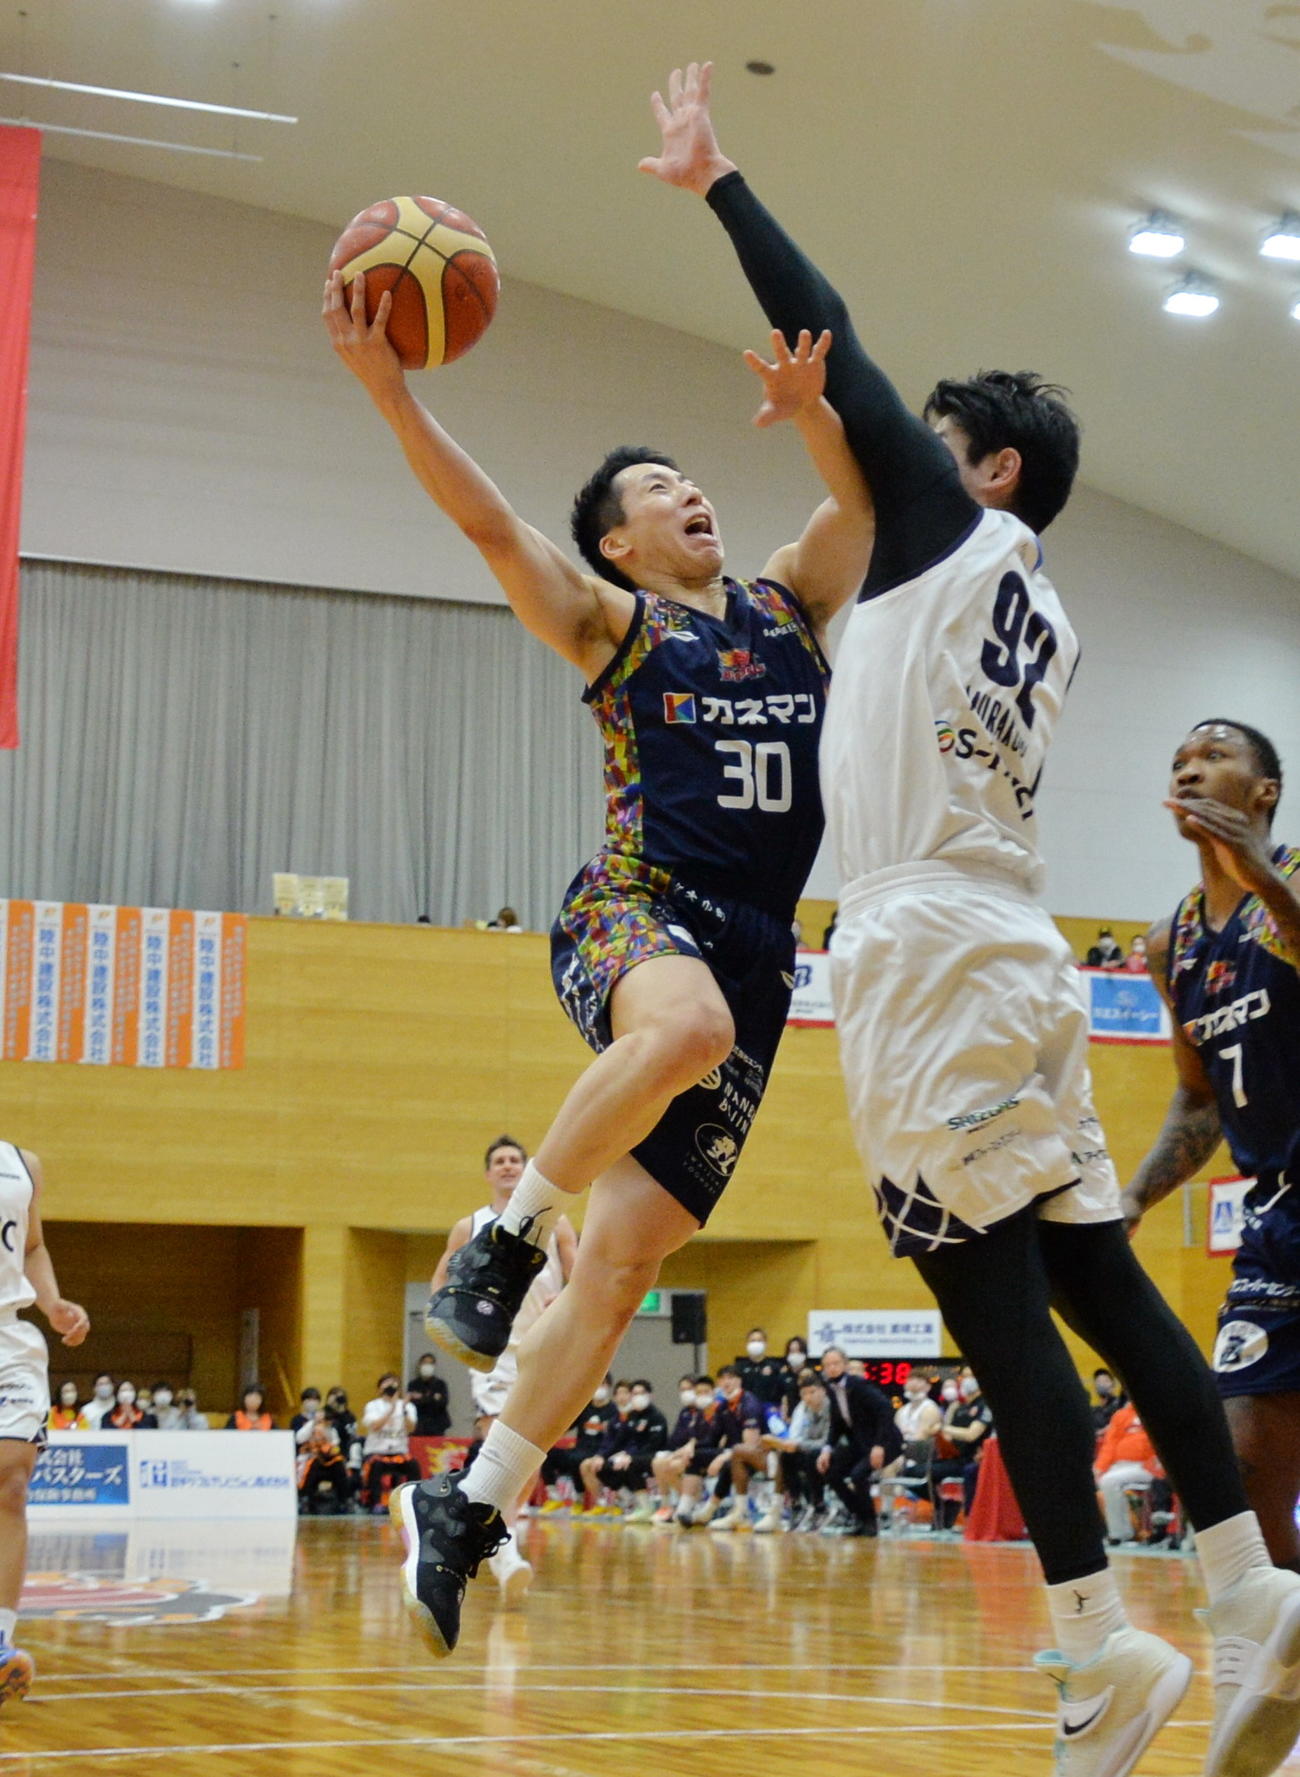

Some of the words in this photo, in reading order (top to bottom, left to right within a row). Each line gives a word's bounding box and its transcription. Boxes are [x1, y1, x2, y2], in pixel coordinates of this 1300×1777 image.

[701, 694, 816, 725] カネマン
[714, 740, 793, 813] 30
[1218, 1043, 1248, 1108] 7
[31, 1464, 123, 1485] バスターズ
